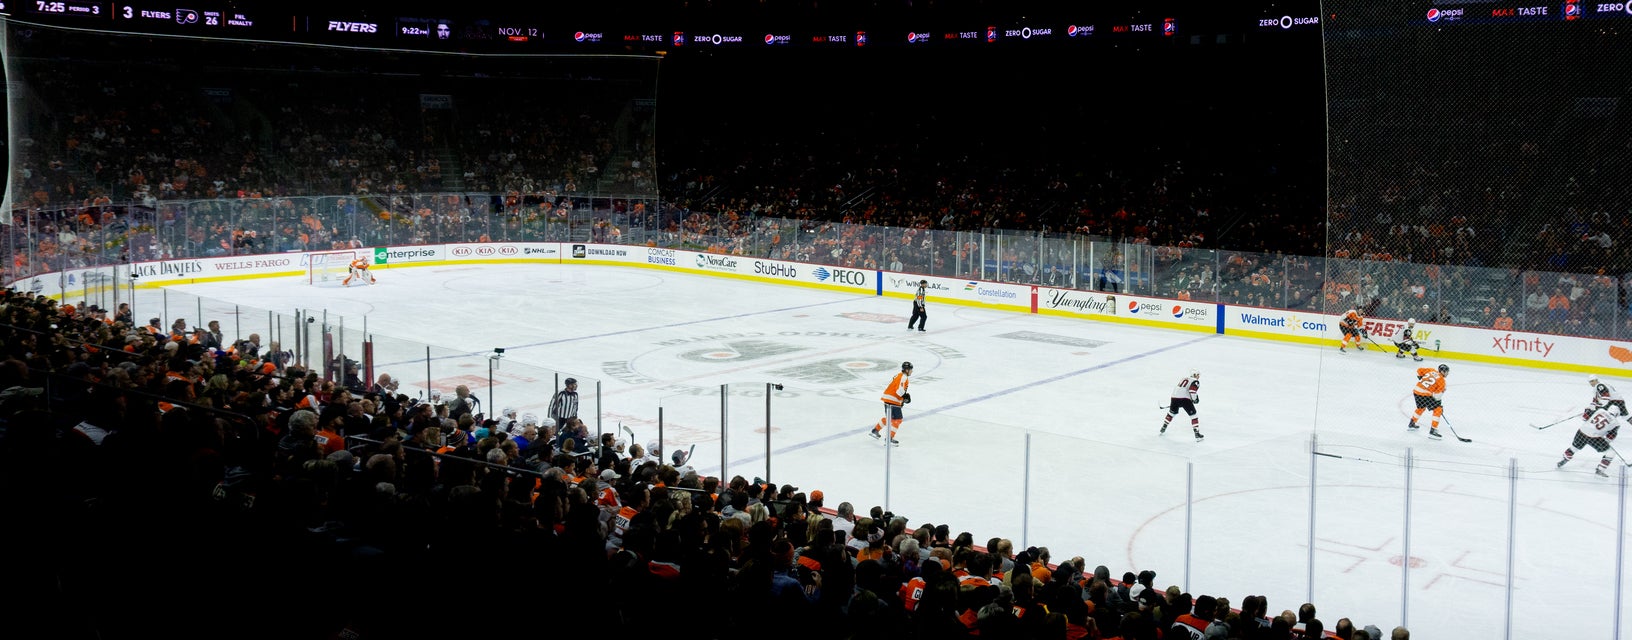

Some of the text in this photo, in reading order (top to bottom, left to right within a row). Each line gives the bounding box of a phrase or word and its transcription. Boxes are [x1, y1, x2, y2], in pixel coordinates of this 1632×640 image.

[36, 0, 66, 12] 7:25
[91, 6, 100, 15] 3
[123, 6, 171, 20] 3 FLYERS
[1517, 6, 1549, 17] TASTE
[1596, 3, 1624, 12] ZERO
[1441, 8, 1464, 19] pepsi
[205, 16, 219, 26] 26
[227, 19, 253, 27] PENALTY
[1259, 16, 1320, 28] ZERO SUGAR
[327, 20, 378, 34] FLYERS
[498, 26, 524, 37] NOV.
[528, 27, 538, 37] 12
[1005, 27, 1053, 38] ZERO SUGAR
[1077, 25, 1095, 35] pepsi
[1130, 23, 1153, 33] TASTE
[584, 32, 603, 40] pepsi
[642, 33, 664, 42] TASTE
[694, 35, 743, 43] ZERO SUGAR
[774, 34, 791, 43] pepsi
[828, 35, 848, 43] TASTE
[915, 31, 931, 41] pepsi
[959, 31, 979, 40] TASTE
[376, 247, 436, 261] enterprise
[587, 248, 615, 256] DOWNLOAD
[647, 247, 676, 258] COMCAST
[215, 260, 252, 271] WELLS
[254, 258, 290, 269] FARGO
[647, 255, 677, 266] BUSINESS
[706, 255, 738, 268] NovaCare
[132, 263, 157, 277] JACK
[754, 260, 797, 278] StubHub
[832, 269, 866, 286] PECO
[977, 286, 1017, 299] Constellation
[1046, 288, 1107, 312] Yuengling
[1140, 302, 1207, 316] pepsi pepsi
[1241, 313, 1286, 328] Walmart
[1492, 333, 1555, 358] xfinity
[1590, 413, 1611, 431] 55
